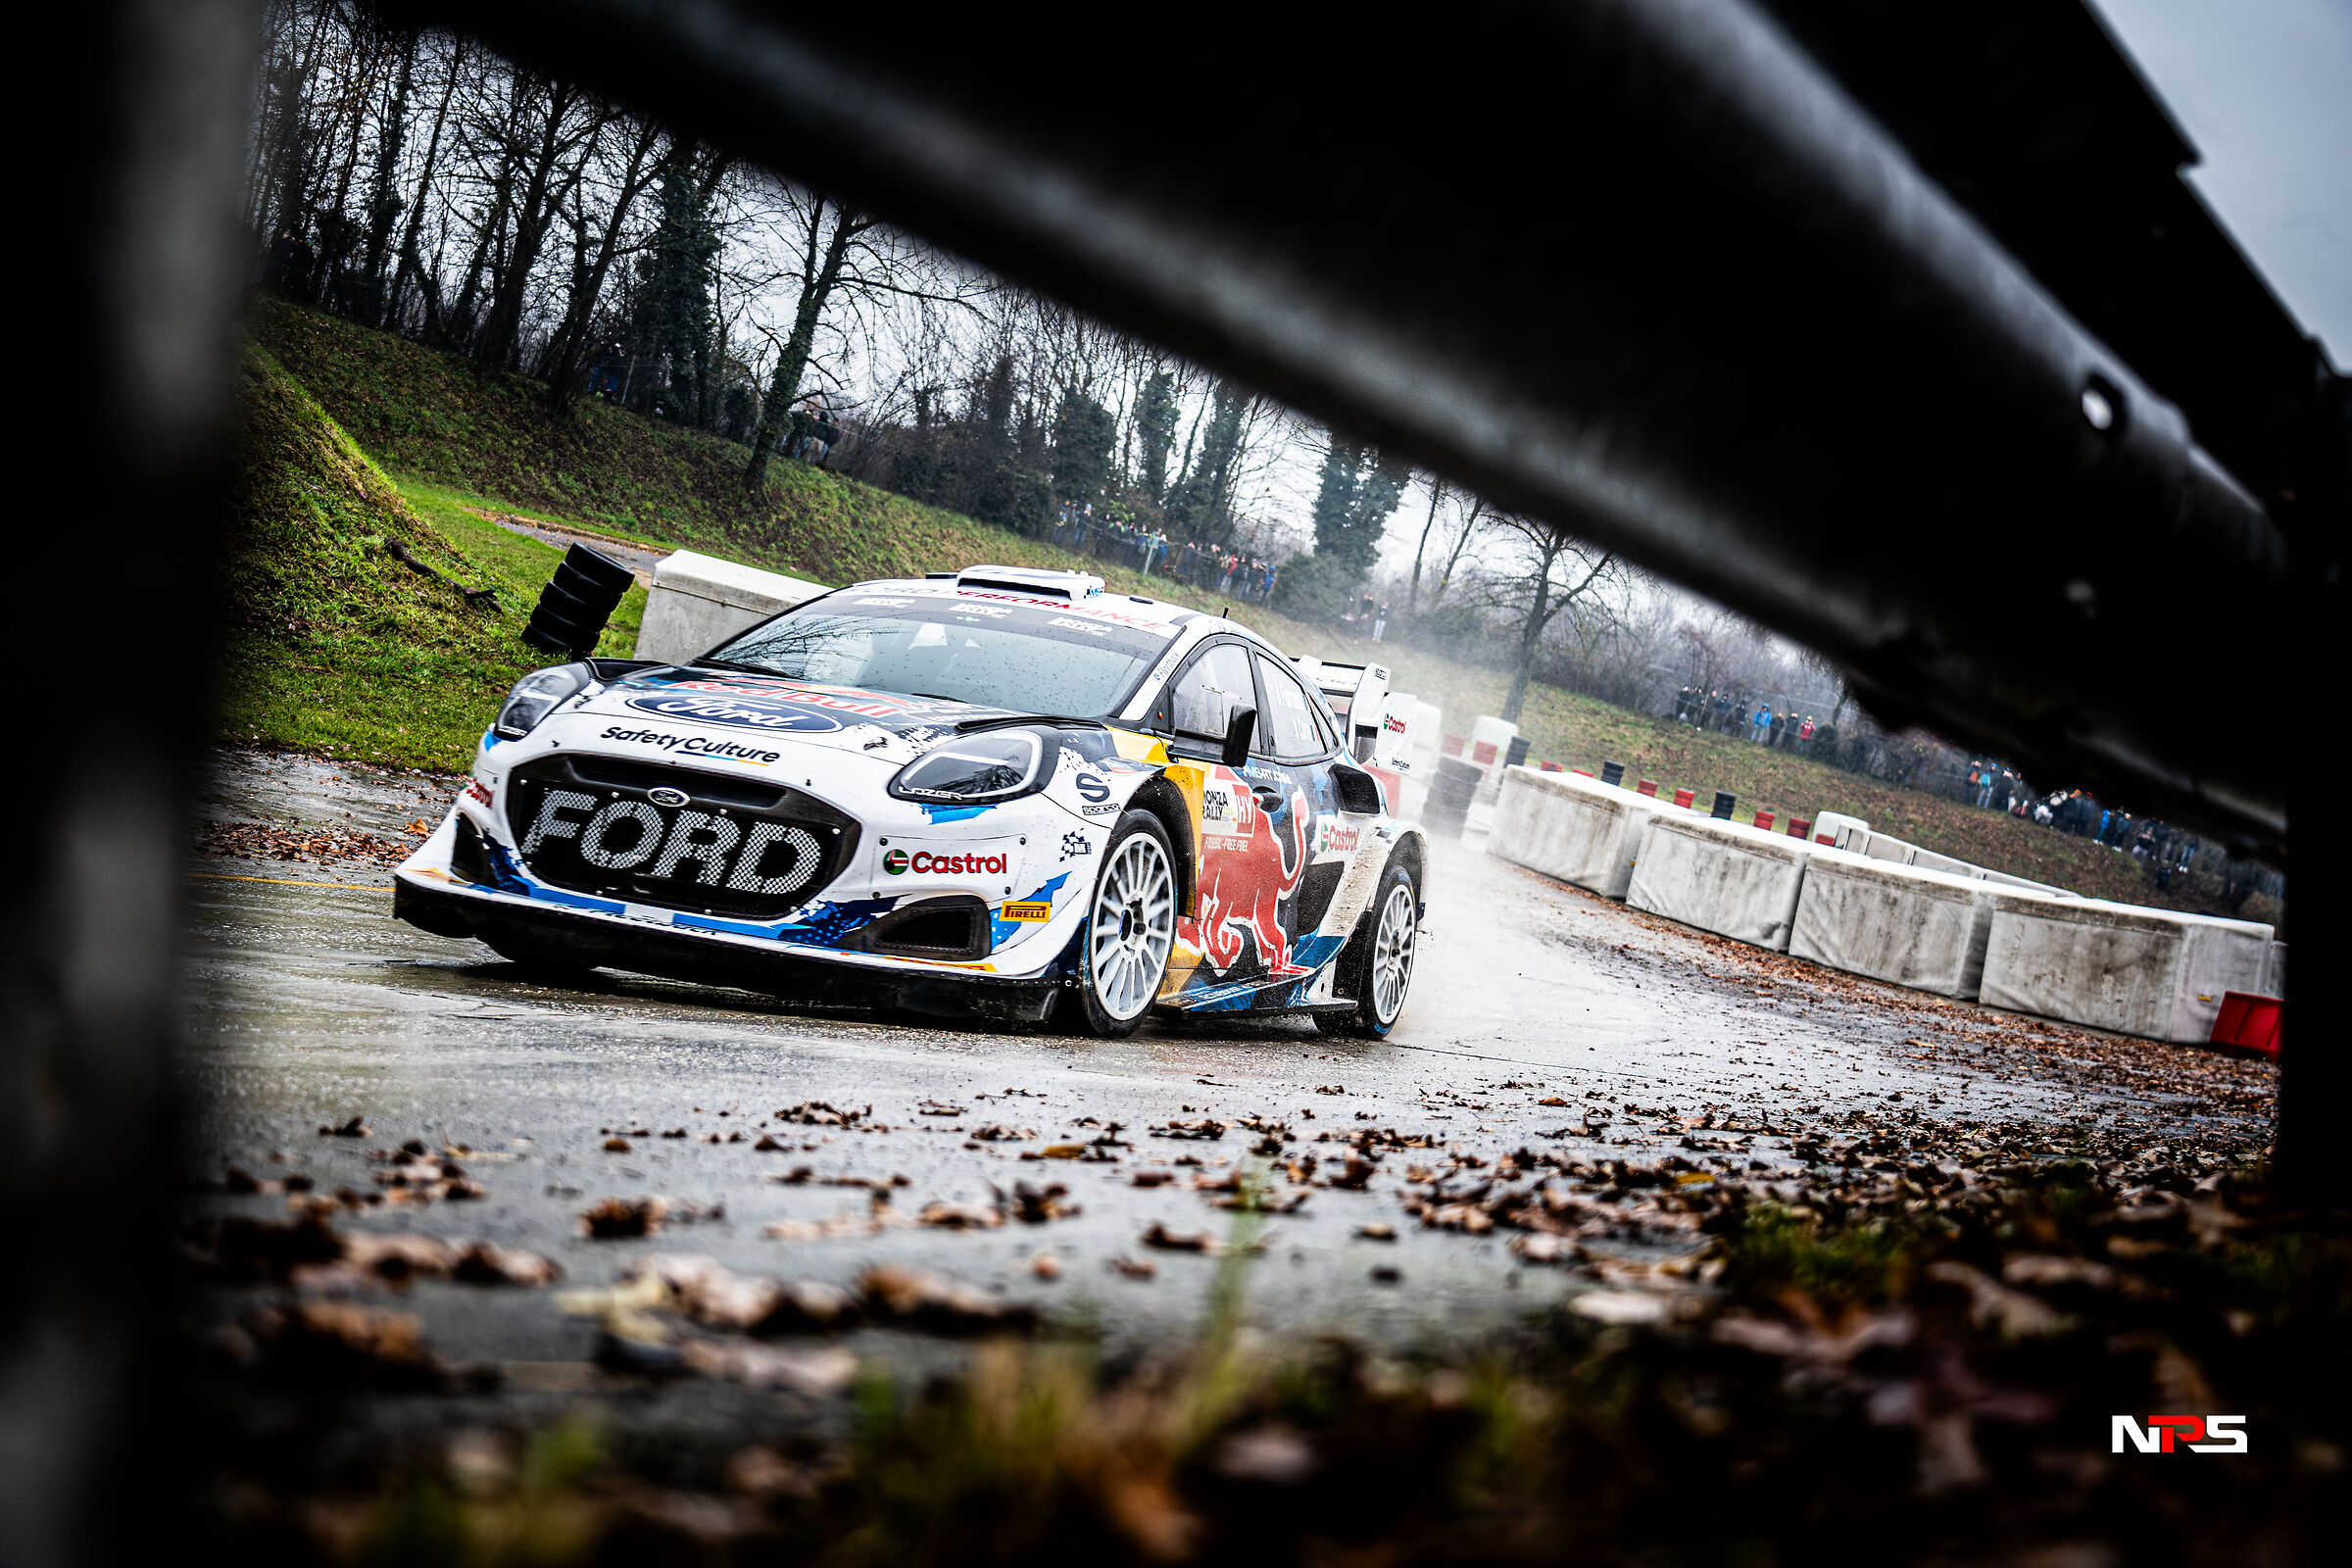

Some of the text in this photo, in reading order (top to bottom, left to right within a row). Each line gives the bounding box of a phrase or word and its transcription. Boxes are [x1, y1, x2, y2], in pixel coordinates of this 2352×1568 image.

[657, 696, 810, 726] Ford
[667, 680, 787, 697] Red
[780, 691, 900, 716] Bull
[600, 726, 780, 762] SafetyCulture
[520, 789, 821, 894] FORD
[1329, 825, 1360, 851] Castrol
[911, 851, 1006, 873] Castrol
[1004, 905, 1047, 918] PIRELLI
